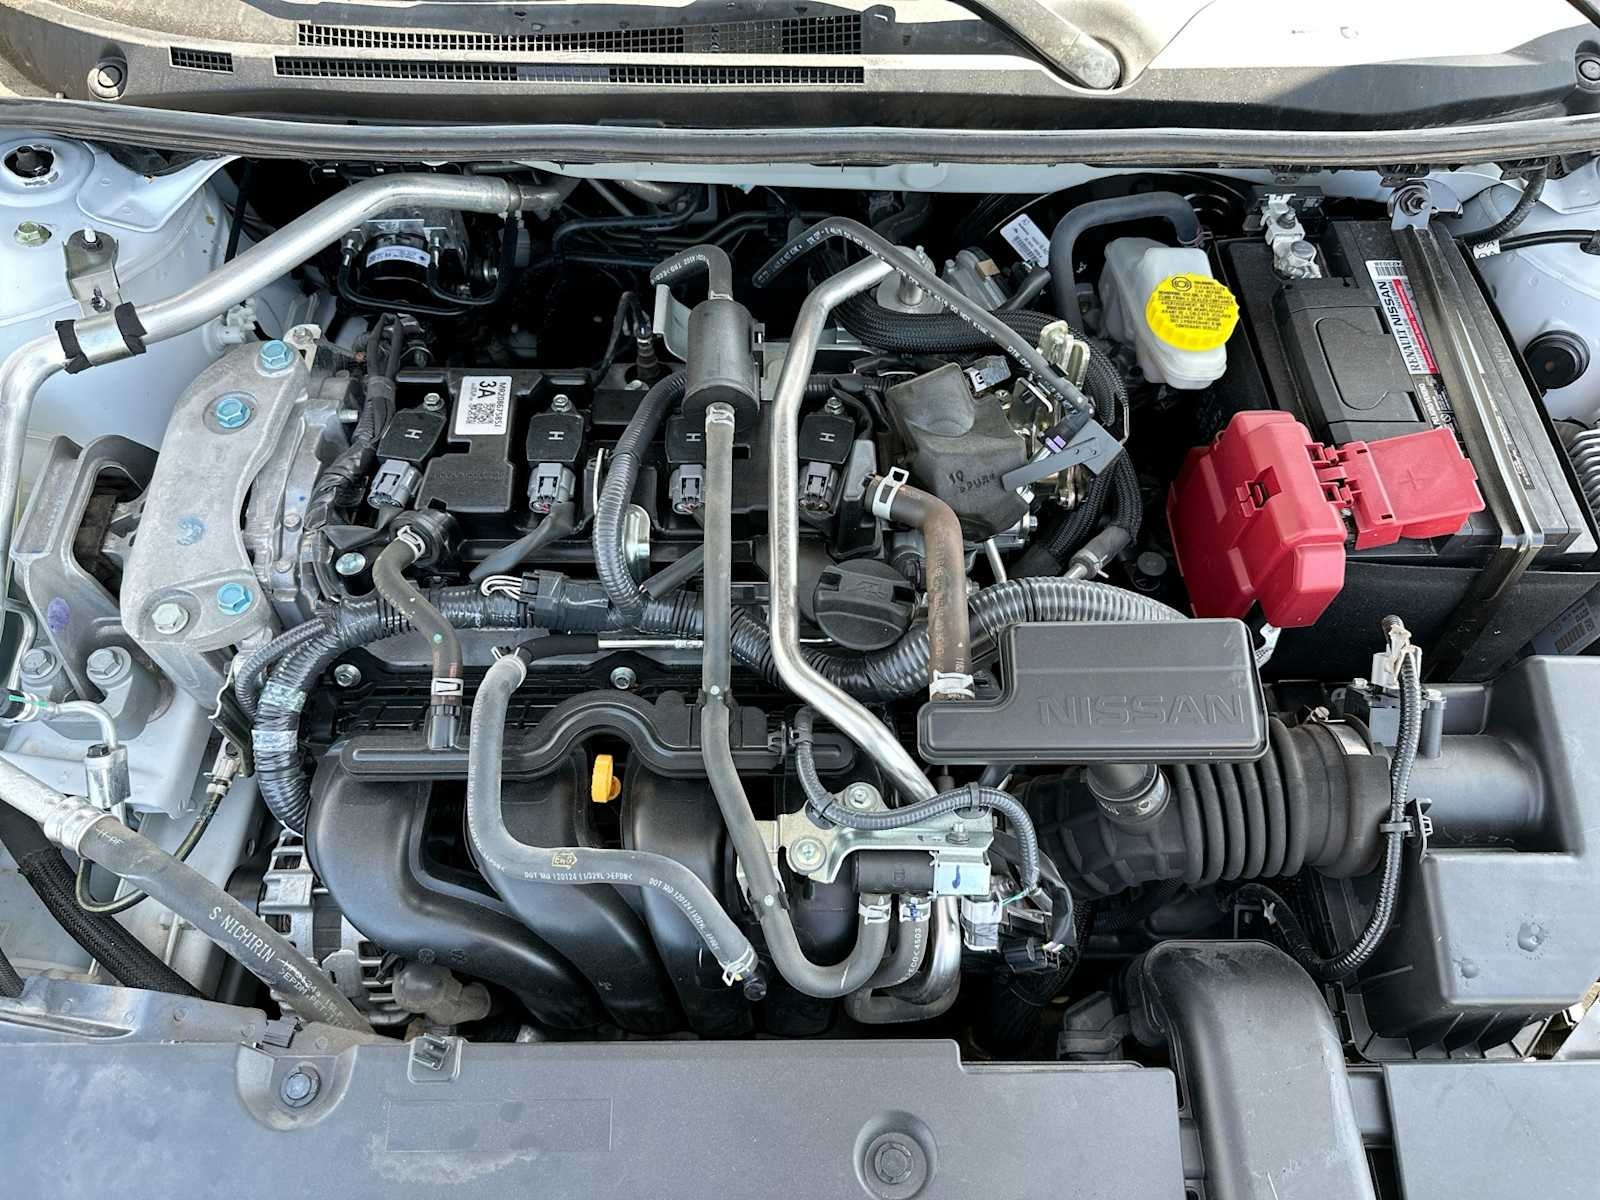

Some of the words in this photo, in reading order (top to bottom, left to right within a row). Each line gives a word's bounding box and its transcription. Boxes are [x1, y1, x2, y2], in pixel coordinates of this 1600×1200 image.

[1376, 281, 1403, 326] NISSAN
[1396, 329, 1422, 371] RENAULT
[477, 381, 497, 398] 3A
[1037, 693, 1245, 728] NISSAN
